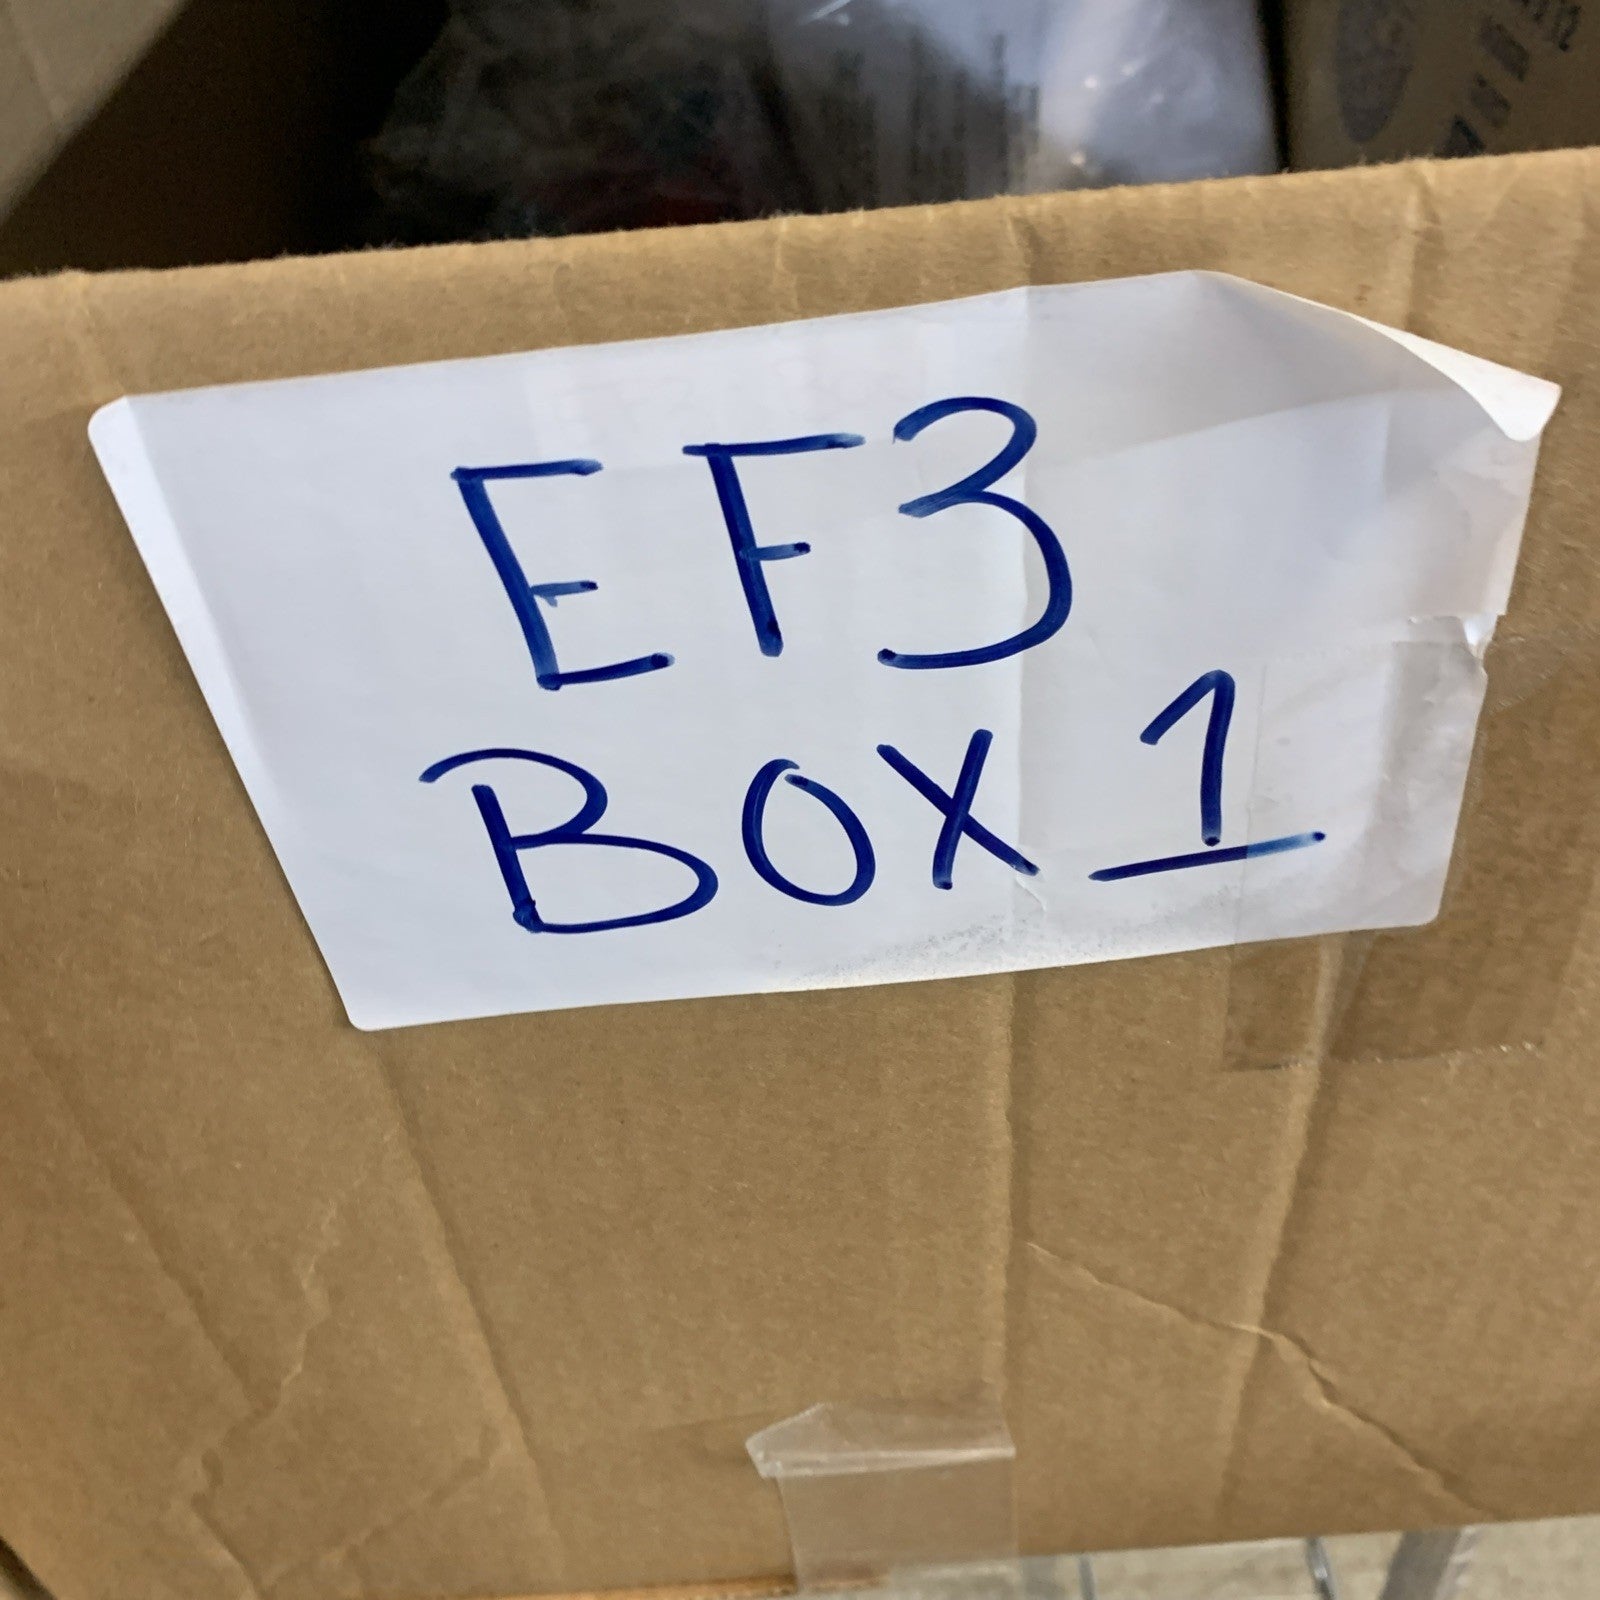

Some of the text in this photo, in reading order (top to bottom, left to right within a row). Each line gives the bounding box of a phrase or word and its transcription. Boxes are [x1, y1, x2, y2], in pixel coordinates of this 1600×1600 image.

[450, 397, 1073, 691] EF3
[420, 669, 1326, 934] BOX 1
